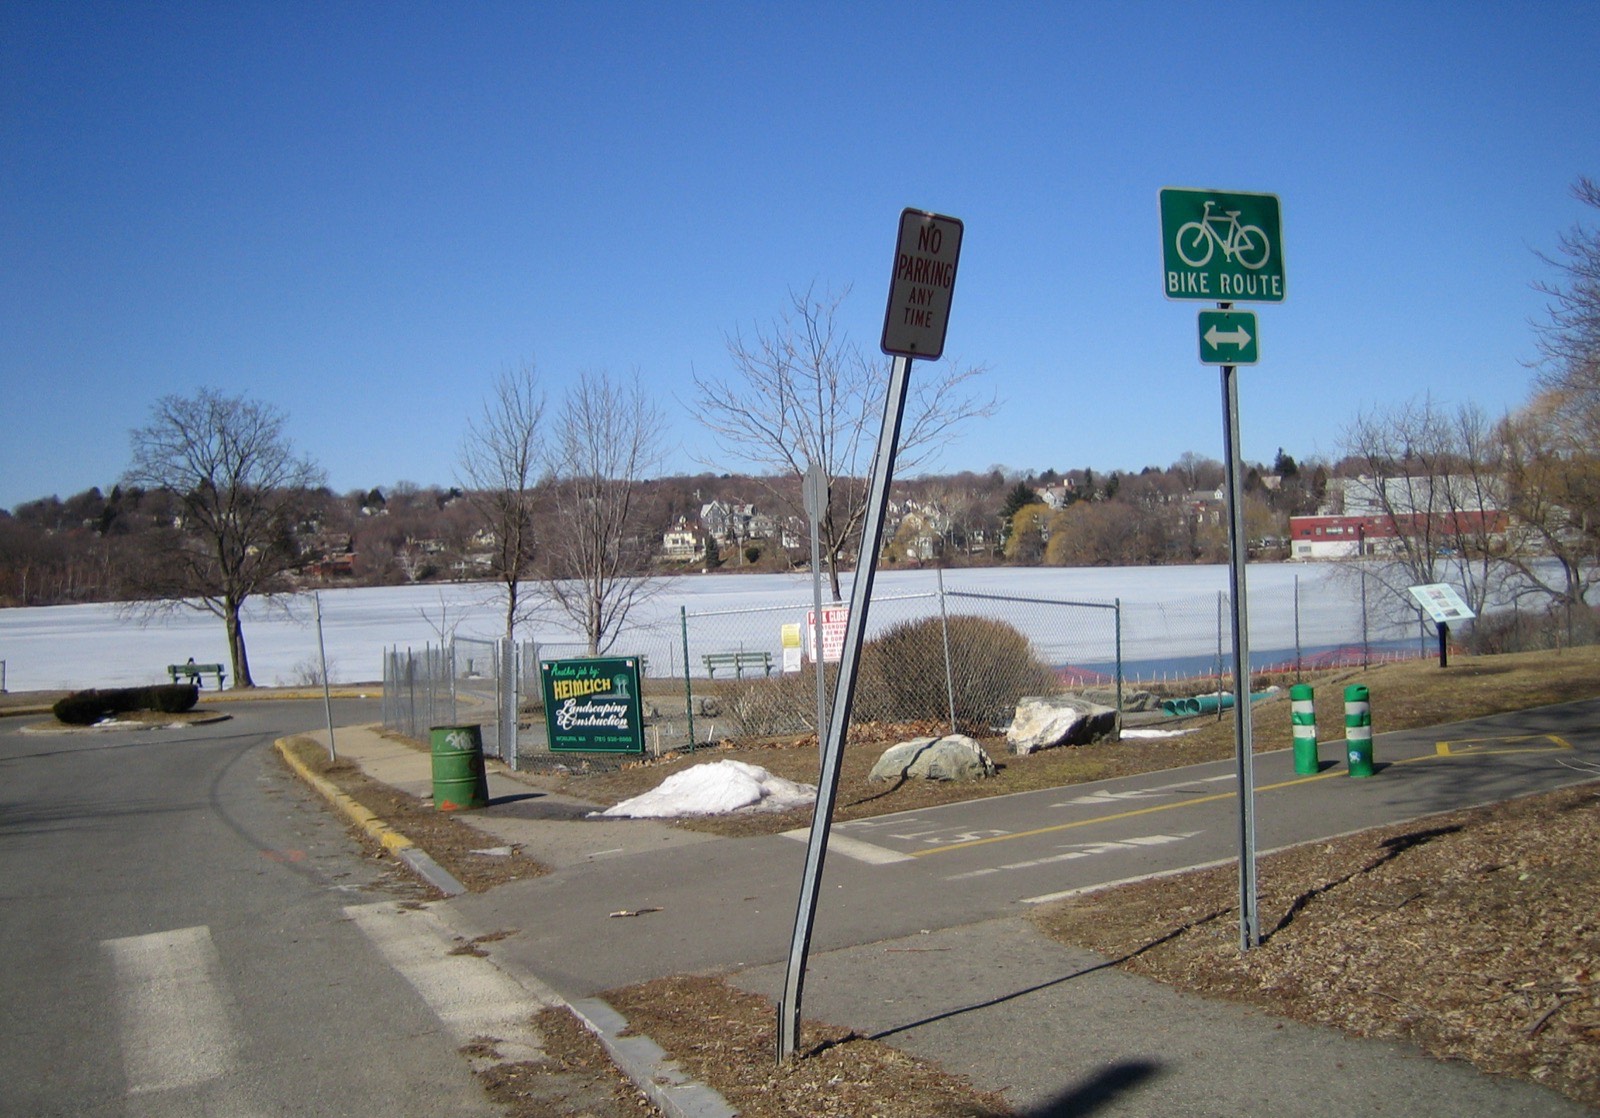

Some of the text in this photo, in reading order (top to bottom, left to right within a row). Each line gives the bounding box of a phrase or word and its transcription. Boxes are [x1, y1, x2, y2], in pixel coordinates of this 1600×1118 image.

[917, 225, 942, 254] NO
[897, 254, 953, 289] PARKING
[1168, 271, 1282, 296] BIKE ROUTE
[908, 286, 934, 307] ANY
[904, 307, 933, 329] TIME
[551, 663, 600, 679] Another job by:
[553, 678, 611, 701] HEIMLICH
[556, 698, 627, 717] Landscaping
